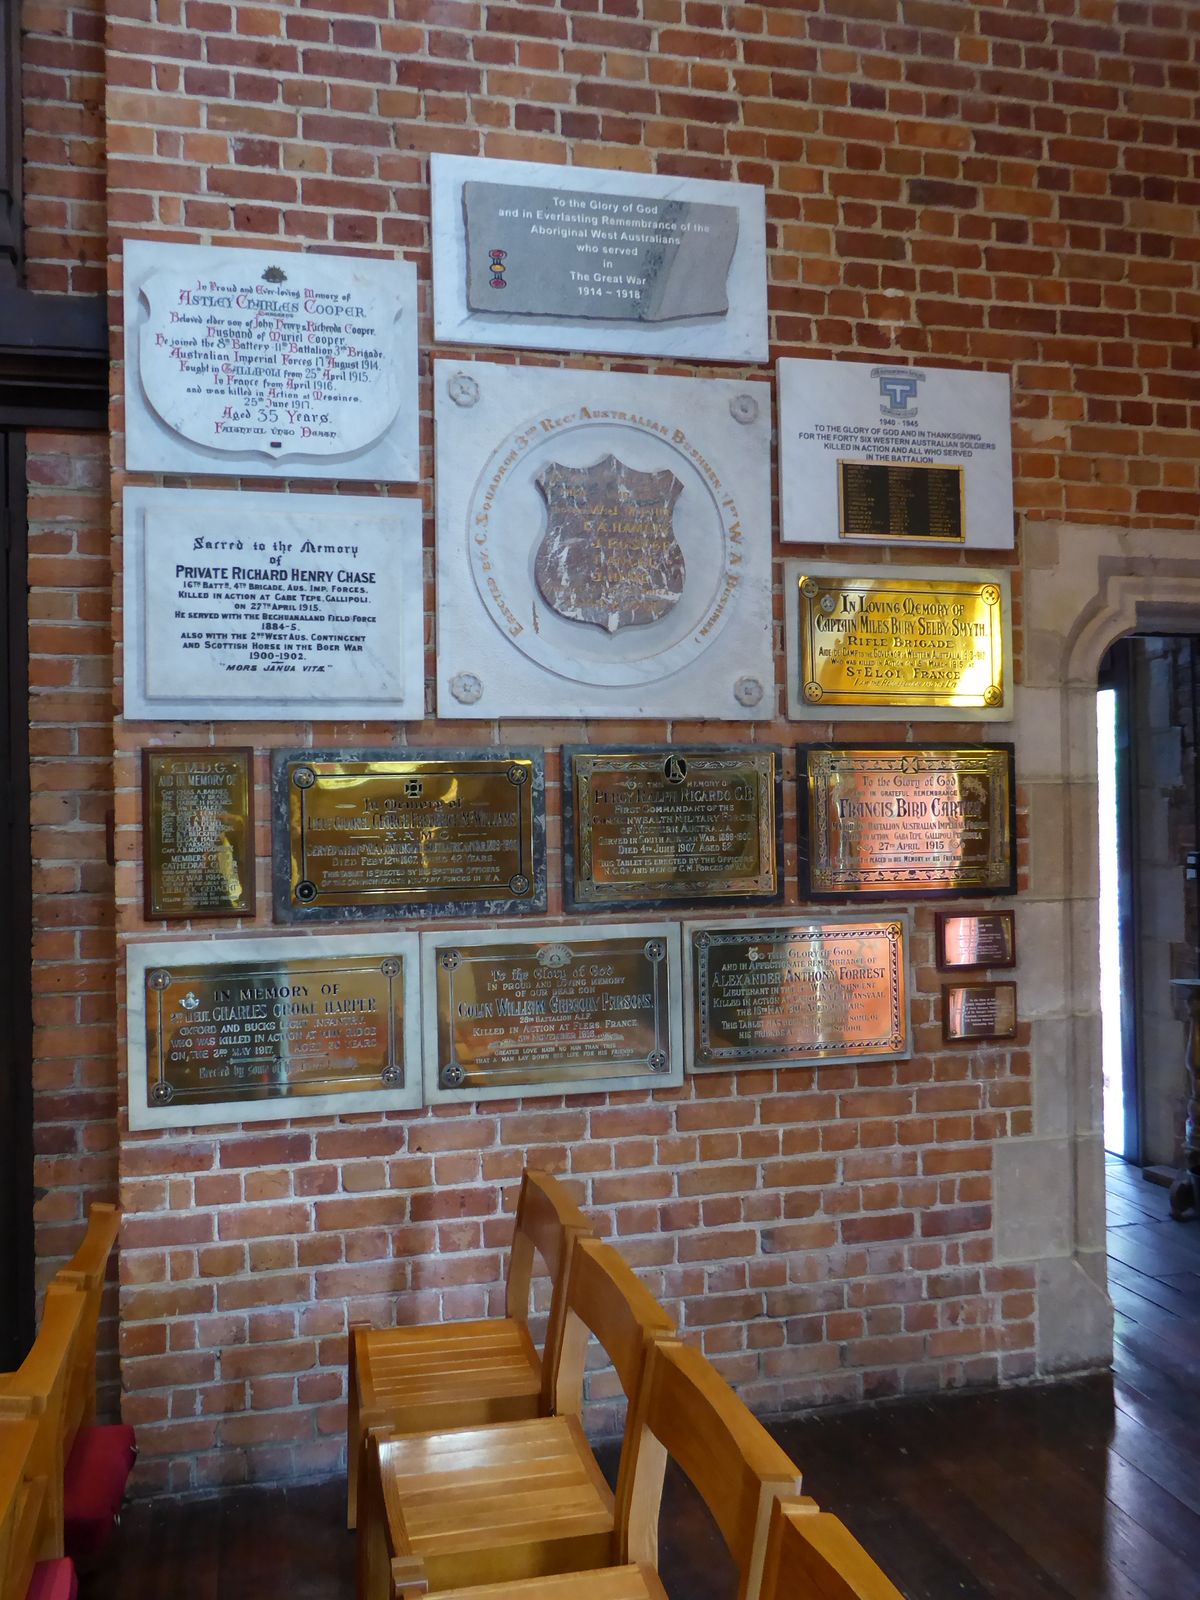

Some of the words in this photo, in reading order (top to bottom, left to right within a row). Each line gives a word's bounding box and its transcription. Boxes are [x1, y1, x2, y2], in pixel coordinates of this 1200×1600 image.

[553, 197, 565, 206] To
[570, 200, 585, 208] the
[590, 200, 618, 213] Glory
[622, 204, 632, 212] of
[637, 204, 657, 214] God
[499, 209, 518, 217] and
[523, 209, 532, 218] in
[537, 210, 598, 226] Everlasting
[602, 216, 677, 230] Remembrance
[681, 223, 690, 231] of
[694, 224, 709, 232] the
[531, 225, 587, 238] Aboriginal
[591, 230, 617, 240] West
[621, 232, 680, 244] Australians
[576, 244, 598, 252] who
[603, 247, 638, 255] served
[603, 259, 613, 268] in
[570, 271, 589, 281] The
[594, 273, 622, 283] Great
[626, 276, 646, 285] War
[197, 280, 207, 291] In
[209, 281, 237, 293] Proud
[240, 286, 253, 294] and
[304, 288, 338, 302] Memory
[342, 293, 351, 301] of
[578, 287, 602, 296] 1914
[617, 290, 640, 299] 1918
[206, 326, 252, 339] Husband
[257, 331, 265, 341] of
[269, 332, 302, 342] Muriel
[169, 347, 229, 360] Australian
[234, 351, 276, 364] Imperial
[281, 354, 312, 366] Forces
[328, 357, 358, 369] August
[214, 374, 223, 385] In
[227, 375, 258, 386] France
[264, 379, 283, 388] from
[287, 379, 310, 390] April
[229, 387, 251, 396] killed
[266, 399, 288, 408] June
[223, 406, 250, 421] Aged
[258, 409, 278, 422] 35
[873, 437, 910, 445] WESTERN
[911, 439, 958, 448] AUSTRALIAN
[927, 432, 981, 441] THANKSGIVING
[892, 455, 933, 463] BATTALION
[943, 449, 972, 457] SERVED
[194, 536, 243, 550] Sacred
[254, 541, 265, 551] to
[273, 541, 292, 554] the
[300, 539, 358, 558] Memory
[270, 555, 282, 566] of
[176, 565, 228, 579] PRIVATE
[232, 567, 288, 581] RICHARD
[291, 569, 333, 582] HENRY
[337, 570, 376, 583] CHASE
[953, 604, 965, 616] OF
[205, 641, 247, 649] SCOTTISH
[252, 642, 280, 650] HORSE
[848, 636, 887, 646] RIFLE
[893, 638, 954, 648] BRIGADE
[925, 776, 934, 786] of
[937, 776, 955, 786] God
[926, 841, 944, 849] 1915
[840, 967, 885, 980] FORREST
[214, 989, 230, 1002] IN
[240, 986, 308, 1001] MEMORY
[321, 984, 340, 995] OF
[221, 1025, 240, 1033] AND
[245, 1022, 275, 1031] BUCKS
[219, 1035, 250, 1045] KILLED
[255, 1035, 265, 1043] IN
